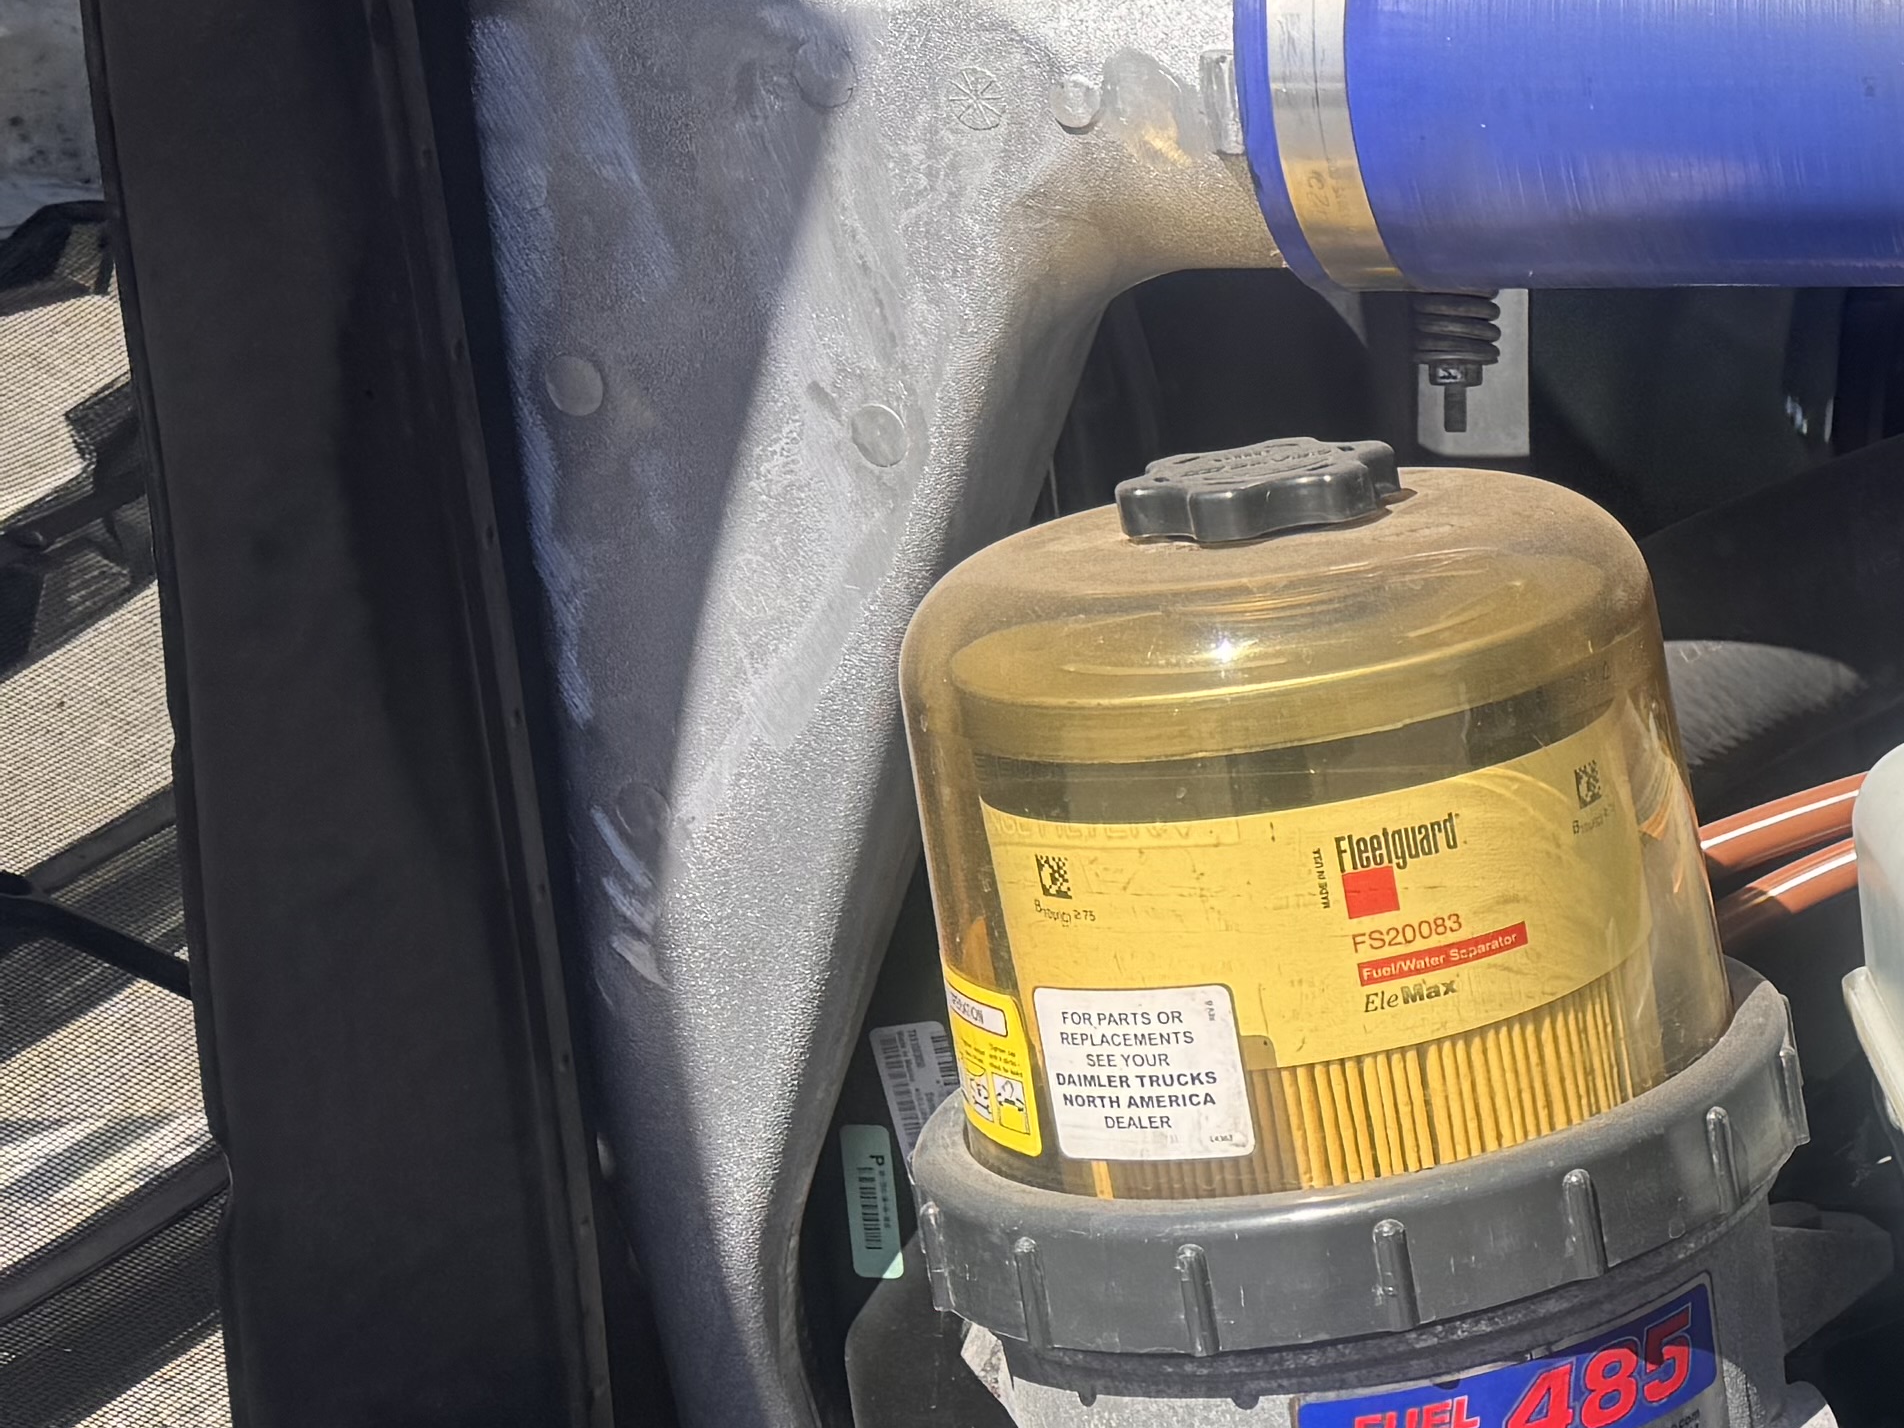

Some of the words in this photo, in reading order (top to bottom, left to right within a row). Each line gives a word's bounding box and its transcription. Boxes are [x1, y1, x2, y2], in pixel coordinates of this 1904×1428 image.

[1334, 812, 1458, 873] Fleetguard
[1320, 885, 1331, 909] MADE
[1352, 913, 1463, 954] FS20083
[1362, 953, 1446, 981] Fuel/Water
[1449, 932, 1518, 963] Separator
[1061, 1011, 1092, 1026] FOR
[1097, 1011, 1151, 1026] PARTS
[1157, 1010, 1183, 1025] OR
[1060, 1030, 1195, 1047] REPLACEMENTS
[1086, 1053, 1117, 1068] SEE
[1120, 1053, 1170, 1068] YOUR
[1056, 1073, 1131, 1089] DAIMLER
[1135, 1071, 1218, 1087] TRUCKS
[1063, 1094, 1122, 1109] NORTH
[1127, 1092, 1217, 1109] AMERICA
[1104, 1115, 1172, 1130] DEALER
